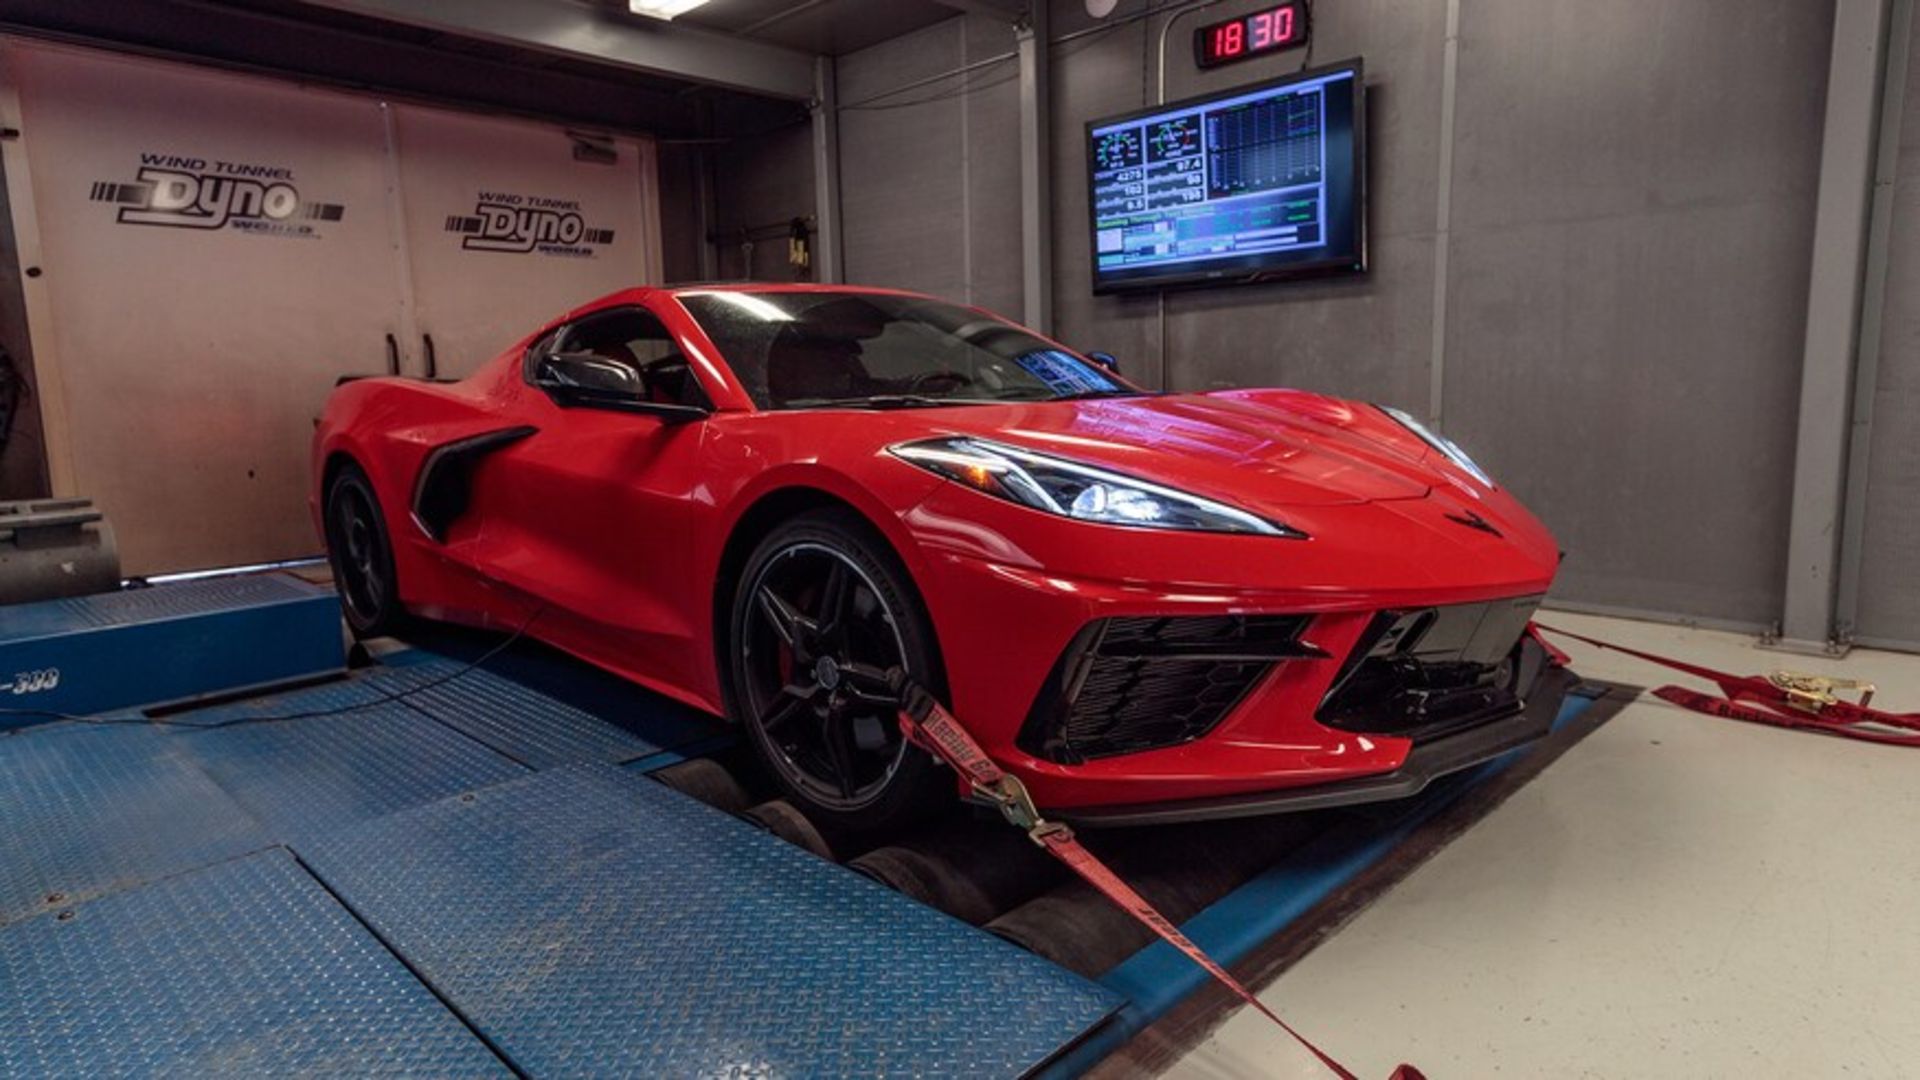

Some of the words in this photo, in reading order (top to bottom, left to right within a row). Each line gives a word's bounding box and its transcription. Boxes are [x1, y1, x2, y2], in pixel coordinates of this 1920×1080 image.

[1215, 22, 1243, 56] 18
[1255, 7, 1294, 48] 30
[140, 152, 207, 170] WIND
[214, 160, 295, 180] TUNNEL
[116, 166, 299, 230] Dyno
[477, 191, 522, 205] WIND
[527, 197, 582, 211] TUNNEL
[462, 203, 584, 253] Dyno
